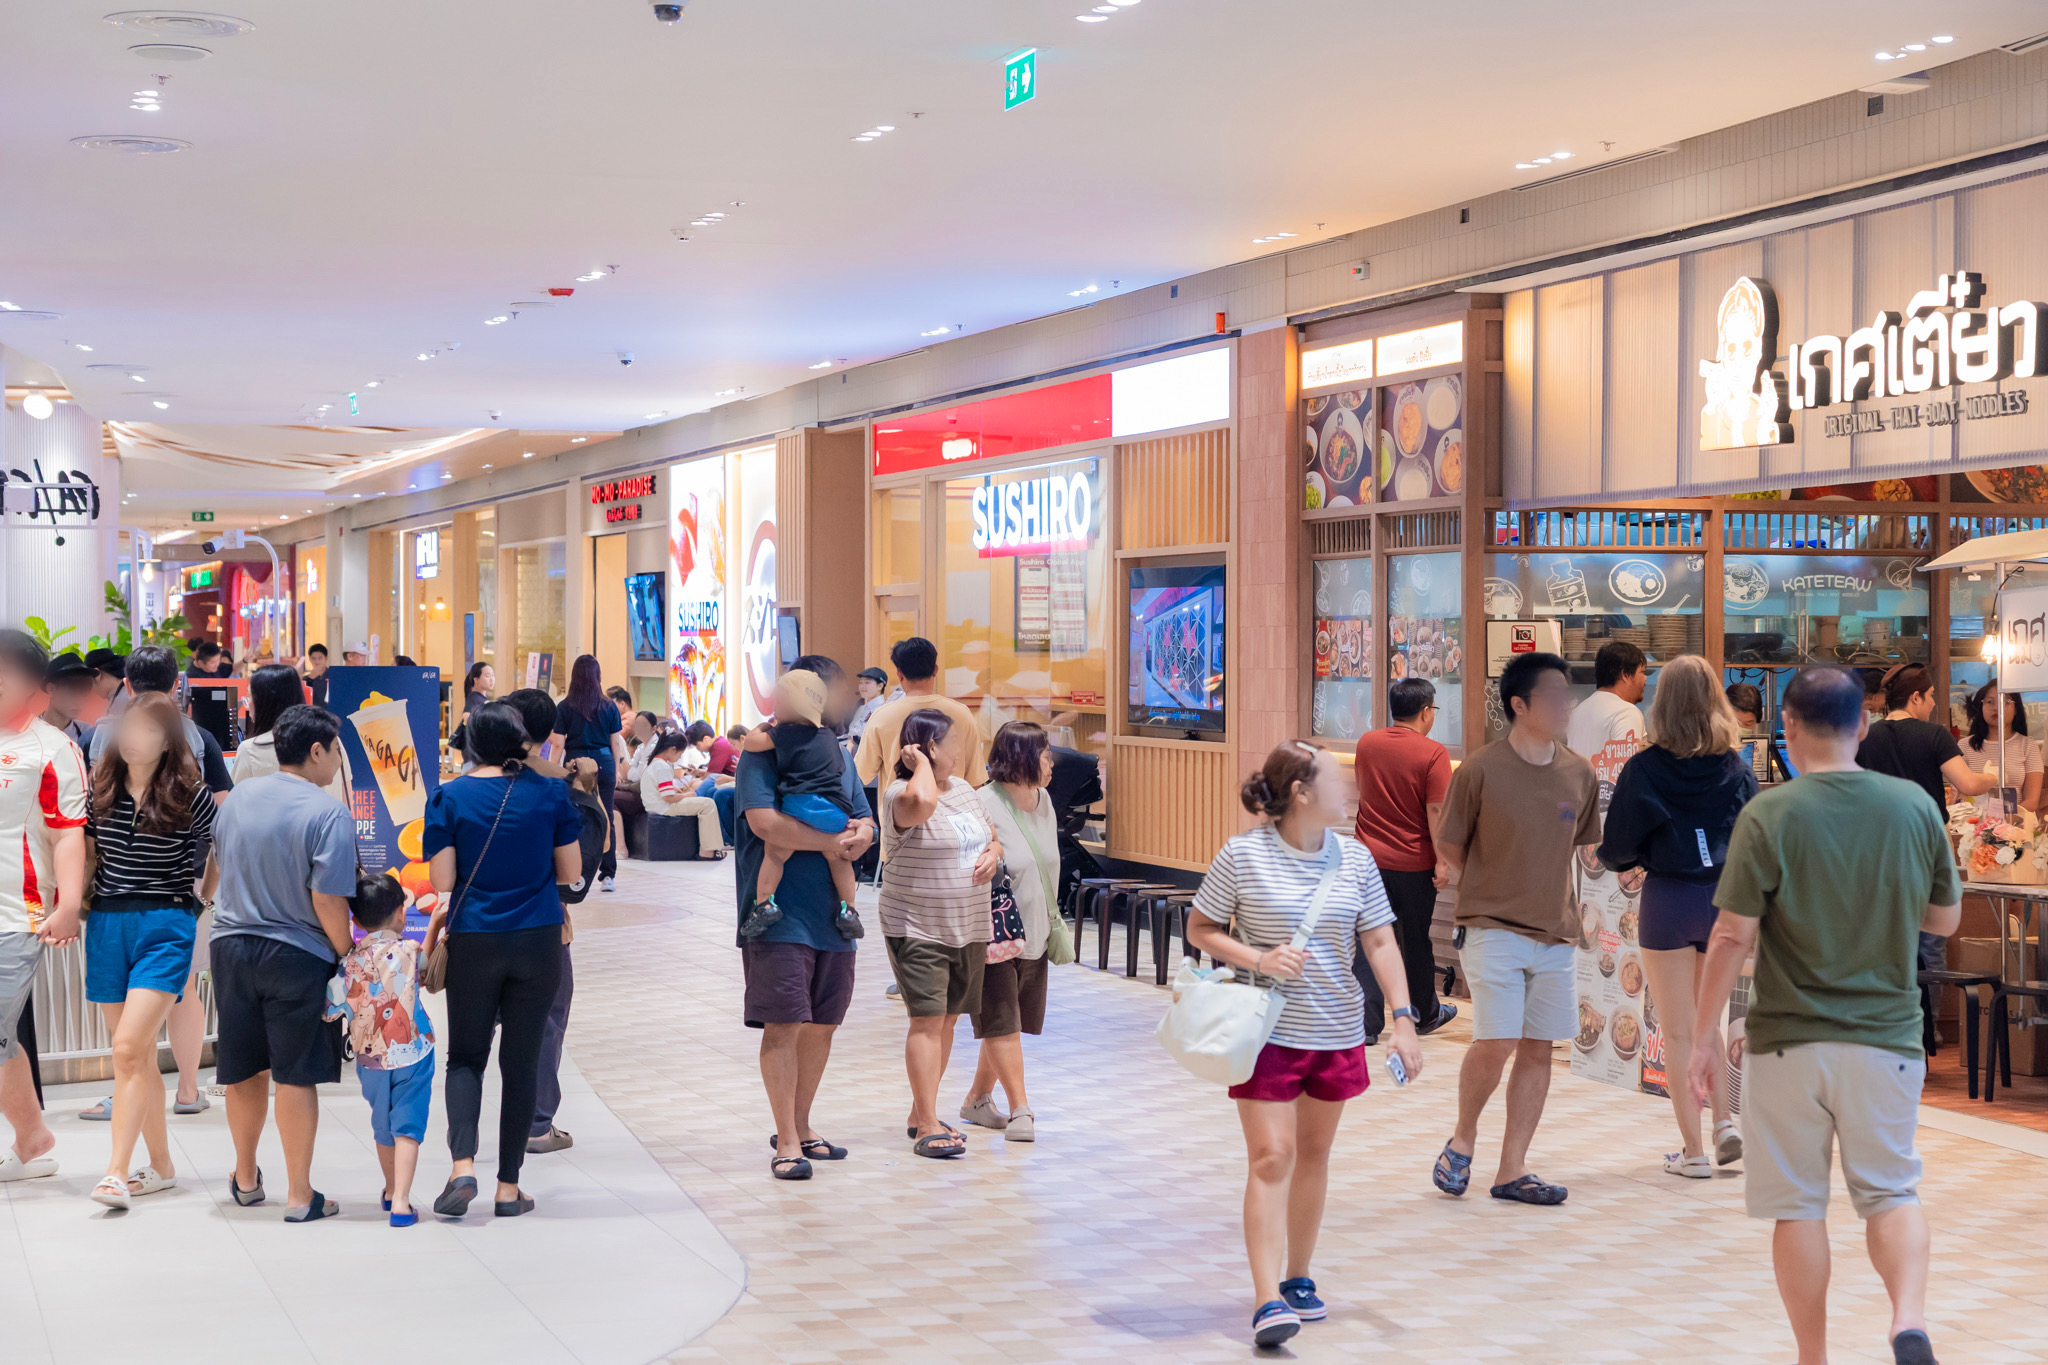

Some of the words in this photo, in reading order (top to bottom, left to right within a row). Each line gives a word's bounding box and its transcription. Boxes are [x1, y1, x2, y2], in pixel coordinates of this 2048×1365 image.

[1823, 410, 1885, 438] ORIGINAL
[1890, 404, 1921, 430] THAI
[1925, 400, 1960, 426] BOAT
[1965, 389, 2030, 420] NOODLES
[972, 471, 1092, 550] SUSHIRO
[1019, 558, 1045, 566] Sushiro
[1781, 574, 1873, 593] KATETEAW
[678, 601, 719, 633] SUSHIRO
[356, 820, 376, 835] PPE
